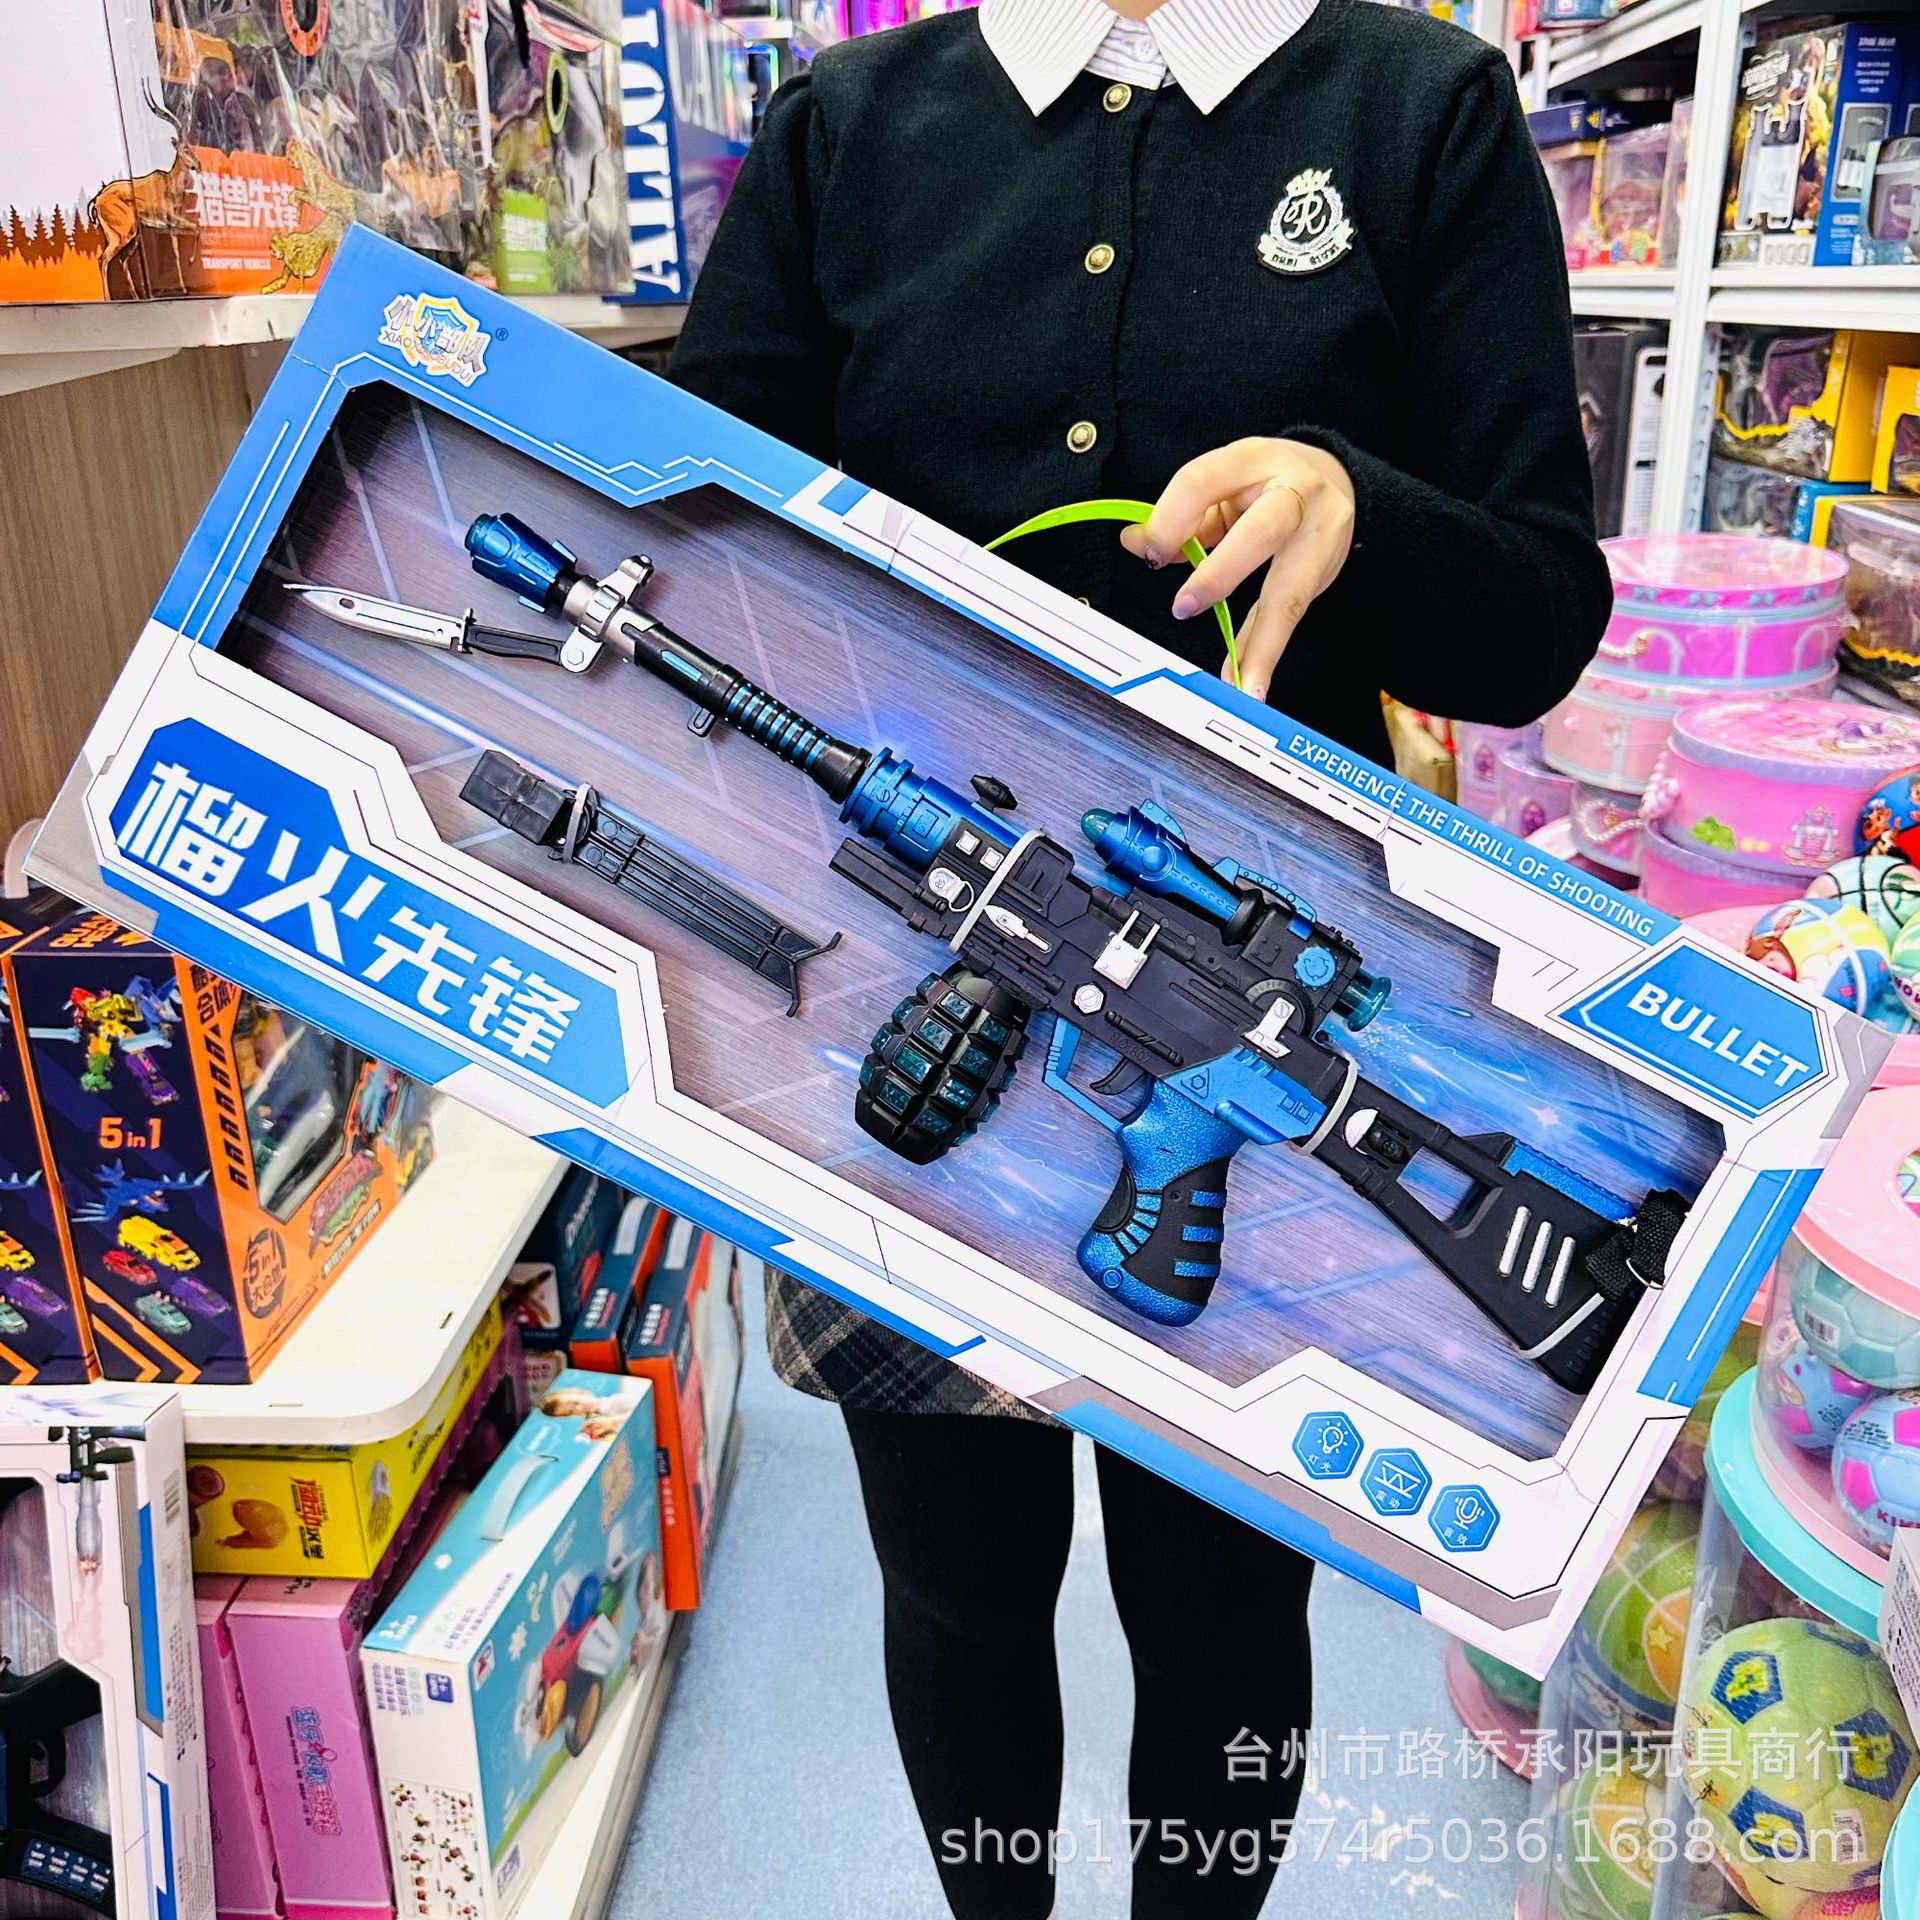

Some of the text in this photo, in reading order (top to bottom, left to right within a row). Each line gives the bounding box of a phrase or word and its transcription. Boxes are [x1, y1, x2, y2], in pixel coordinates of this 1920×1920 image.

[388, 298, 487, 374] 小小部队
[1288, 734, 1655, 938] EXPERIENCE THE THRILL OF SHOOTING
[116, 761, 582, 1064] 榴火先锋
[1626, 981, 1811, 1088] BULLET
[1307, 1452, 1333, 1473] 灯光
[1375, 1489, 1401, 1510] 震动
